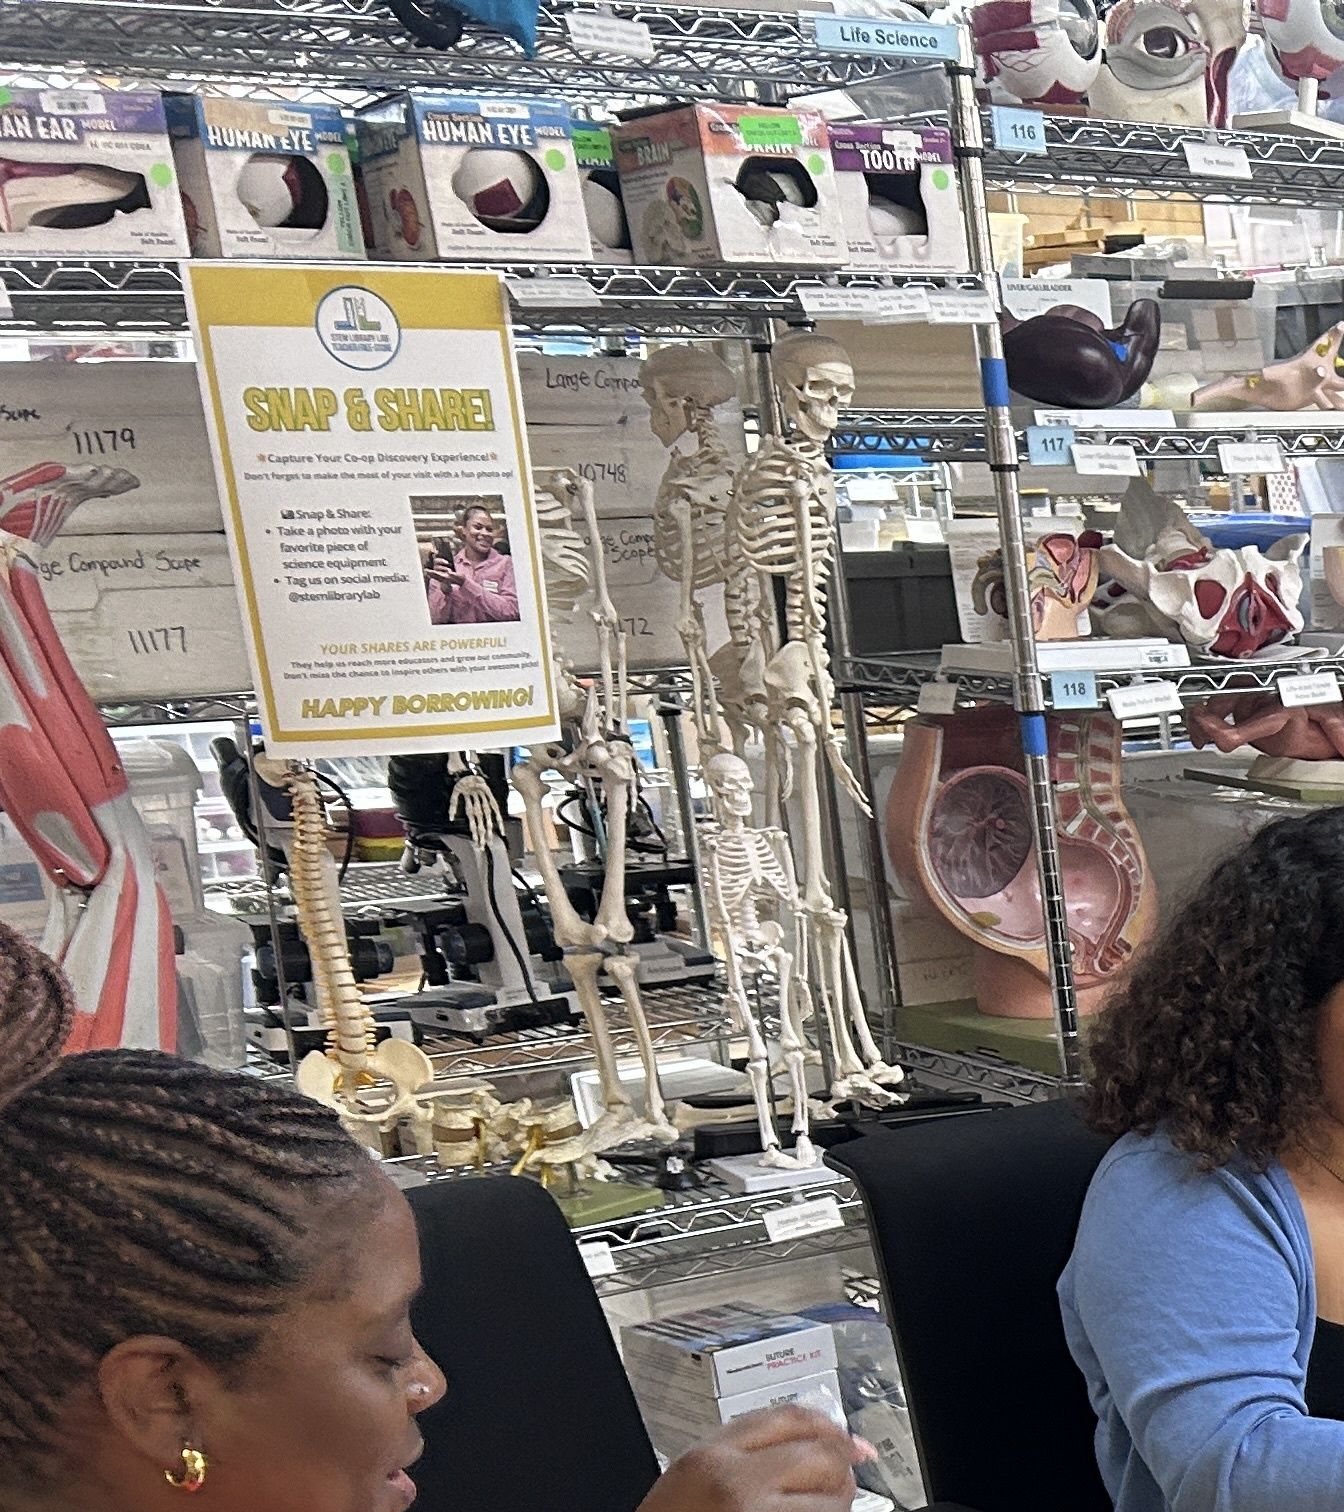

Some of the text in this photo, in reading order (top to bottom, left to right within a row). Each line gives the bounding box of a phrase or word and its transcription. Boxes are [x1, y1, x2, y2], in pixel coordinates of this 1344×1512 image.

[840, 26, 938, 49] Life Science
[37, 119, 78, 141] EAR
[208, 124, 276, 149] HUMAN
[282, 129, 313, 151] EYE
[422, 119, 494, 144] HUMAN
[498, 123, 533, 146] EYE
[1010, 123, 1036, 141] 116
[861, 149, 915, 171] TOOTH
[546, 368, 590, 392] Large
[243, 386, 496, 432] SNAP & SHARE!
[73, 428, 136, 454] 11179
[1041, 437, 1065, 452] 117
[268, 453, 313, 465] Capture
[316, 453, 342, 463] Your
[377, 453, 428, 465] Discovery
[578, 463, 627, 483] 10748
[295, 510, 323, 522] Snap
[277, 526, 305, 536] Take
[316, 525, 349, 539] photo
[351, 525, 374, 535] with
[376, 527, 402, 537] your
[280, 541, 368, 553] favorite piece of
[69, 550, 145, 576] Compound
[156, 551, 200, 573] Scope
[282, 557, 387, 570] science equipment
[285, 576, 305, 587] Tag
[308, 577, 322, 585] us
[340, 574, 372, 584] social
[128, 626, 188, 654] 11177
[320, 637, 507, 655] YOUR SHARES ARE POWERFUL!
[1063, 682, 1086, 697] 118
[302, 685, 534, 719] HAPPY BORROWING!
[809, 1350, 822, 1361] KIT
